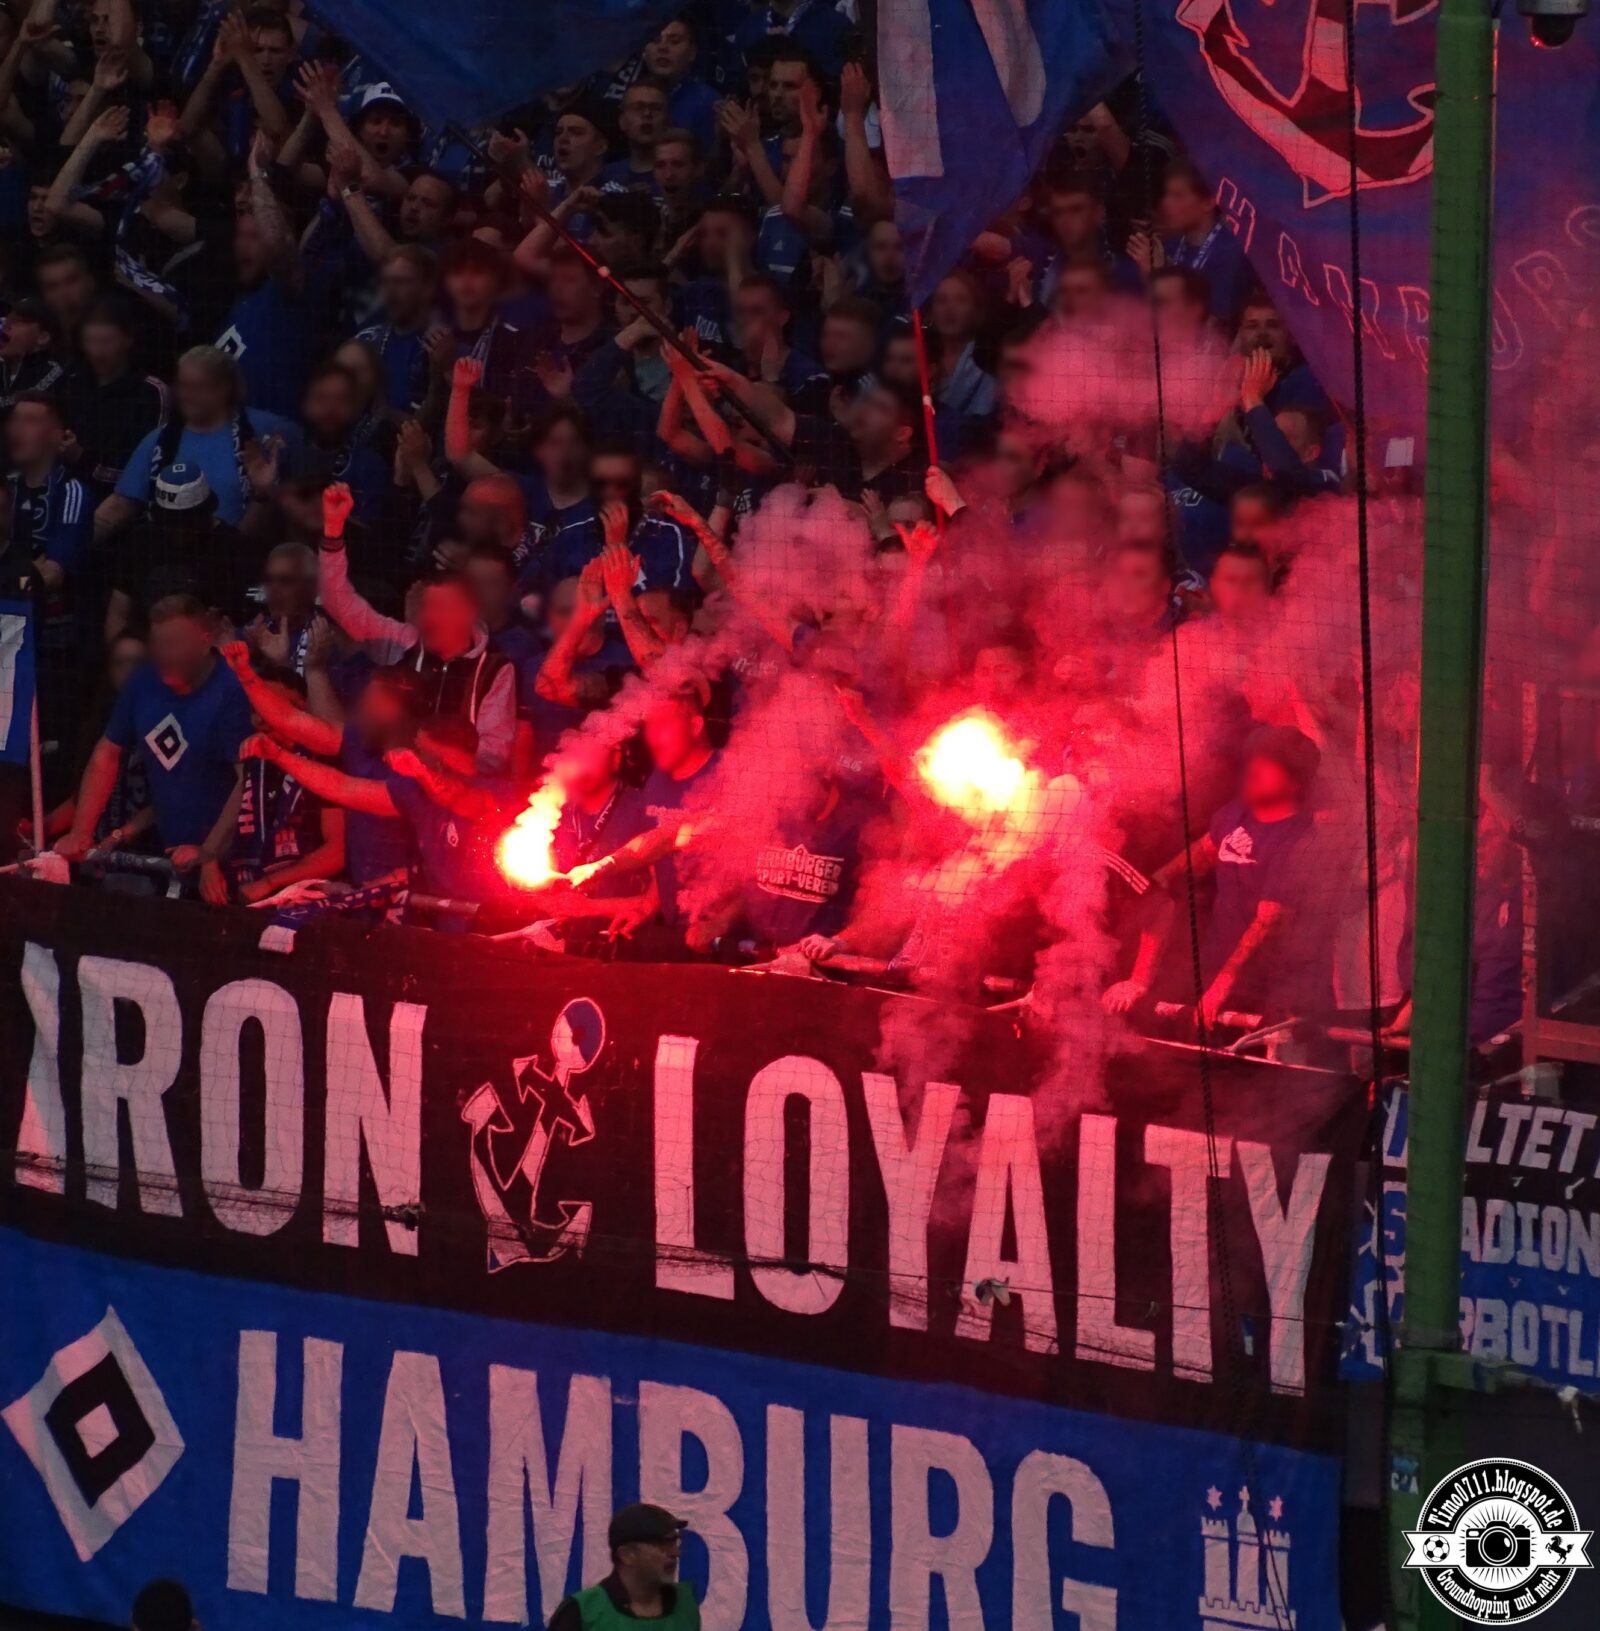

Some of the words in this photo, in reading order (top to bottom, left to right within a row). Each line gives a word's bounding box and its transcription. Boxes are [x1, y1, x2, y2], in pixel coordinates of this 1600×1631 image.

[14, 940, 428, 1257] IRON
[653, 1034, 1333, 1397] LOYALTY
[227, 1329, 1118, 1631] HAMBURG
